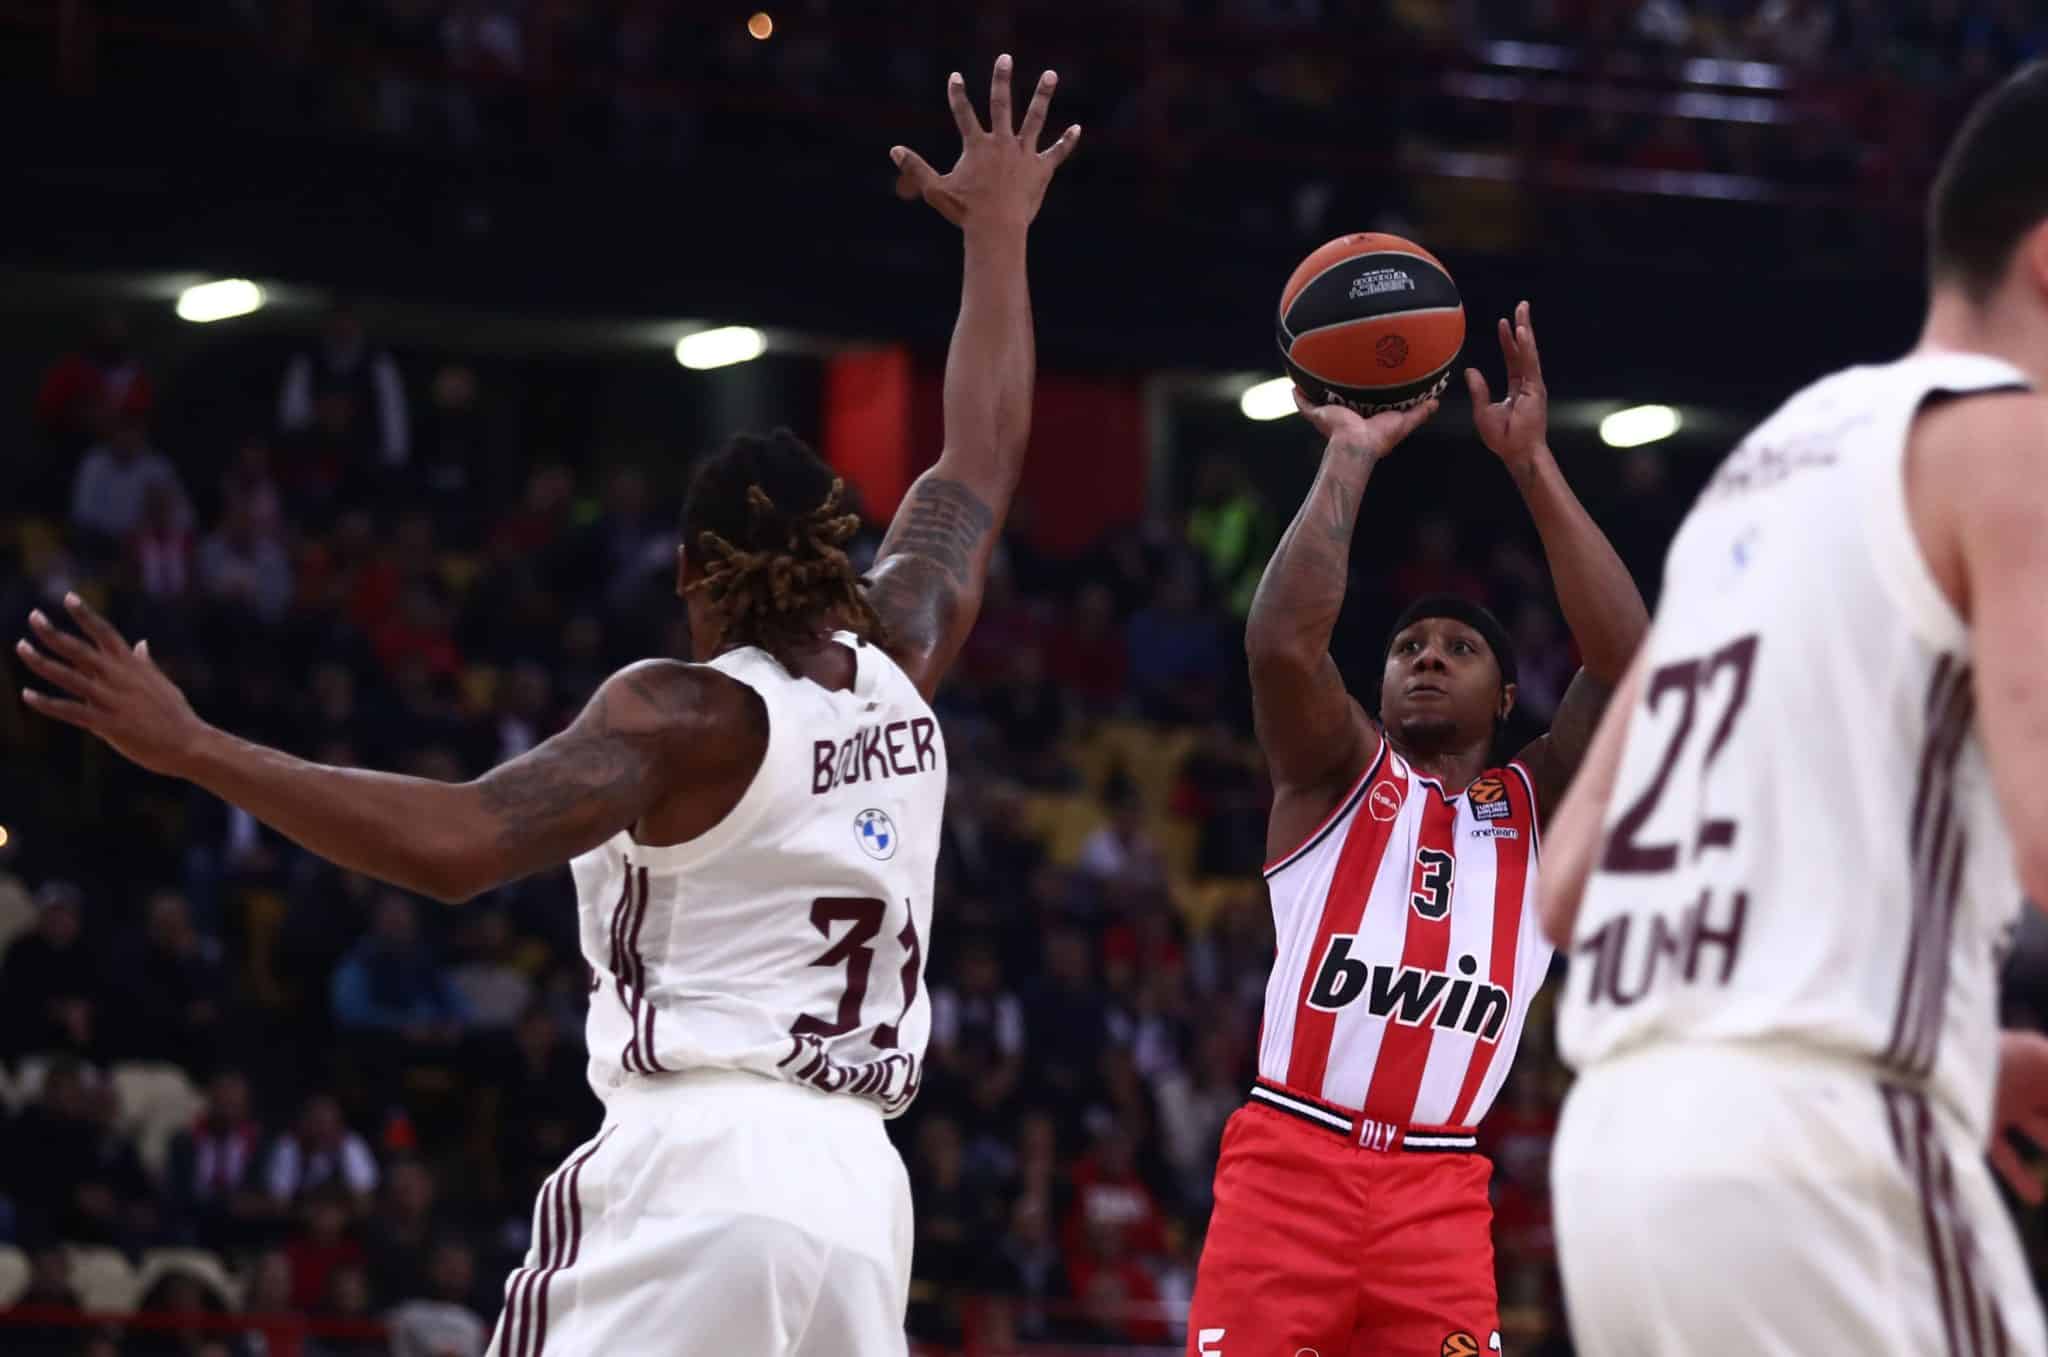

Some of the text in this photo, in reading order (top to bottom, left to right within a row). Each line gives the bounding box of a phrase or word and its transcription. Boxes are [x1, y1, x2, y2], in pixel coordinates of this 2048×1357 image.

[1411, 847, 1455, 921] 3
[789, 897, 921, 1049] 31
[1308, 935, 1510, 1042] bwin
[1358, 1119, 1397, 1152] OLY
